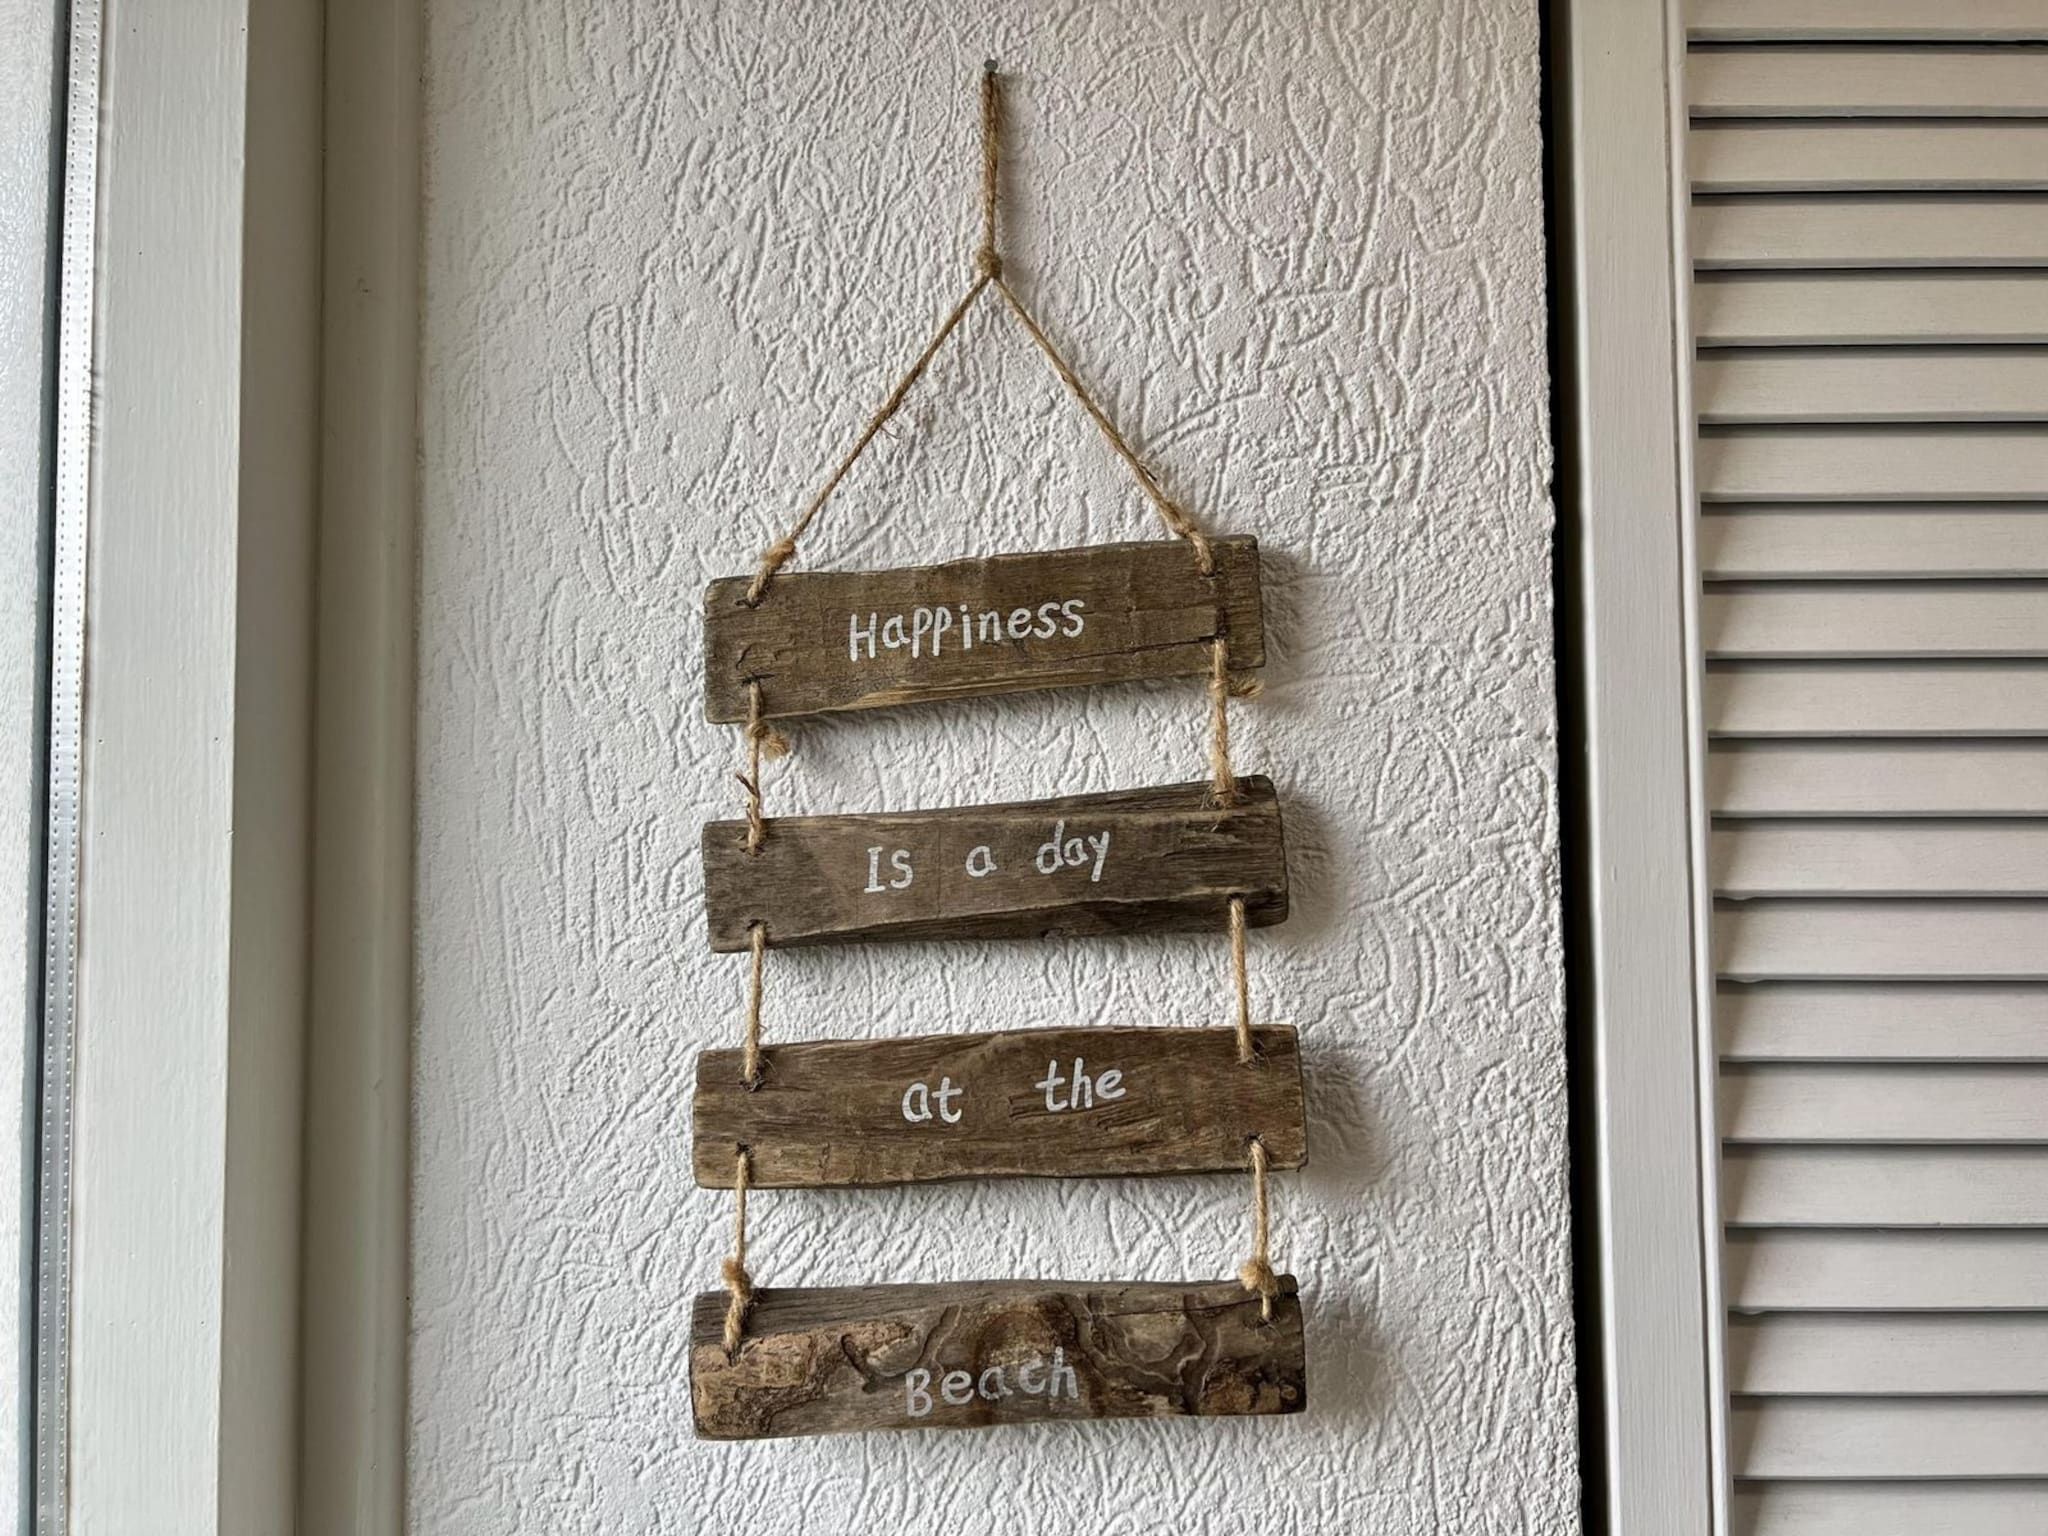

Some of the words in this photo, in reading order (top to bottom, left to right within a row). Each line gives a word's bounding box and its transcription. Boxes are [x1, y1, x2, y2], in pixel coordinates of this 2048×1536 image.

[848, 599, 1085, 662] Happiness
[965, 844, 997, 878] a
[1036, 818, 1110, 882] day
[902, 1076, 963, 1124] at
[1035, 1057, 1126, 1111] the
[905, 1346, 1079, 1417] Beach
